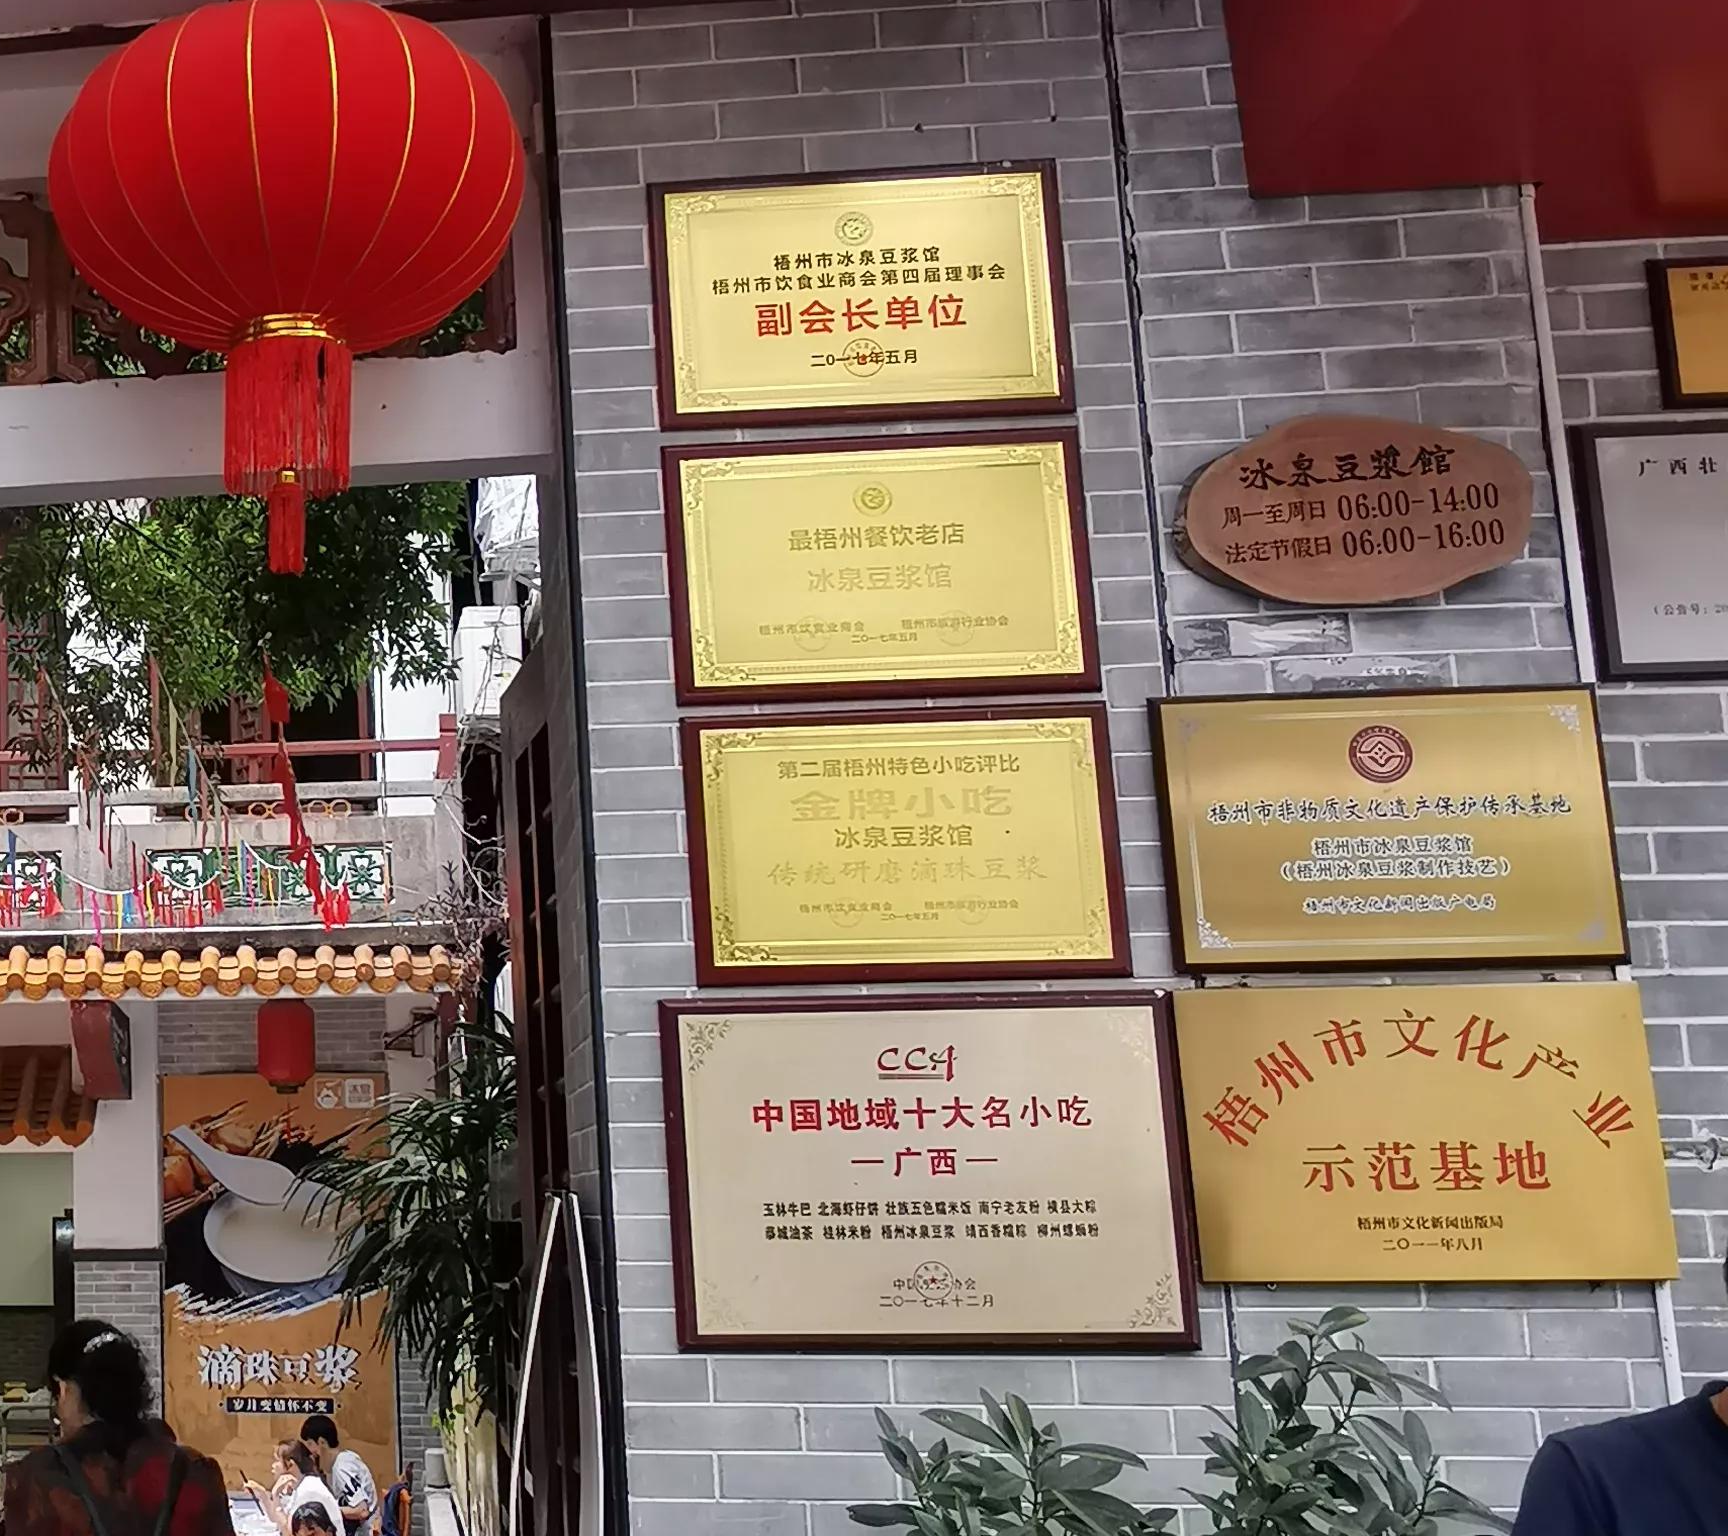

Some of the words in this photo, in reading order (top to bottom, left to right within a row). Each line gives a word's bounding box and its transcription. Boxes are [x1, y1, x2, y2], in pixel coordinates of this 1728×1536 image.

[774, 245, 941, 272] 梧州市冰泉豆浆馆
[712, 263, 1006, 296] 梧州市饮食业商会第四届理事会
[755, 293, 968, 337] 副会长单位
[1221, 499, 1328, 530] 周一至周日
[1336, 482, 1500, 521] 06:00-14:00
[788, 523, 966, 552] 最梧州餐饮老店
[1224, 536, 1333, 565] 法定节假日
[1341, 518, 1506, 558] 06:00-16:00
[807, 562, 953, 594] 冰泉豆浆馆
[777, 753, 1021, 779] 第二届梧州特色小吃评比
[789, 784, 1013, 822] 金牌小吃
[1208, 793, 1573, 824] 梧州市非物质文化遗产保护传承基地
[834, 824, 973, 849] 冰泉豆浆馆
[1312, 835, 1473, 857] 梧州市冰泉豆浆馆
[1202, 1009, 1634, 1149] 梧州市文化产业
[752, 1095, 1093, 1132] 中国地域十大名小吃
[1302, 1140, 1552, 1193] 示范基地
[198, 1344, 362, 1393] 滴珠豆浆
